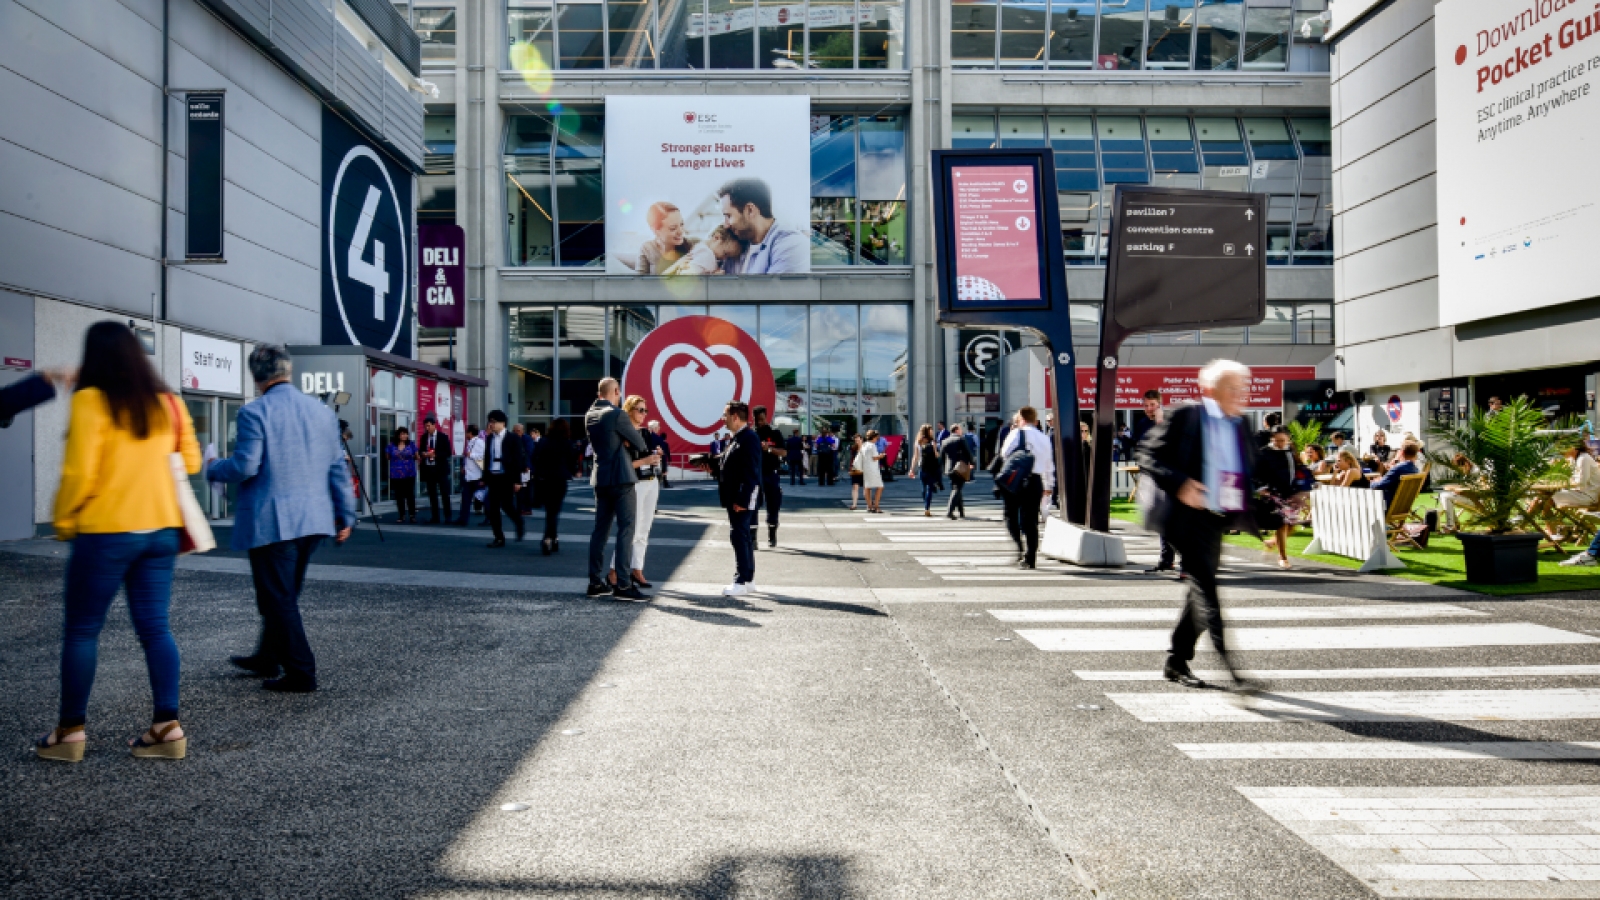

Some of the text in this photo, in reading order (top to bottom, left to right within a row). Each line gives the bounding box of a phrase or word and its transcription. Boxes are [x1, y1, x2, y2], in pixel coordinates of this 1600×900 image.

[1476, 32, 1553, 93] Pocket
[1477, 102, 1496, 124] ESC
[1498, 83, 1536, 114] clinical
[1537, 62, 1586, 99] practice
[1526, 82, 1591, 121] Anywhere
[697, 114, 718, 123] ESC
[661, 142, 756, 155] Stronger Hearts
[671, 158, 746, 170] Longer Lives
[1169, 208, 1176, 216] 7
[1126, 225, 1214, 235] convention centre
[348, 184, 389, 321] 4
[422, 247, 459, 266] DELI
[1126, 243, 1165, 253] parking
[434, 268, 447, 285] &
[193, 351, 233, 372] Staff only
[301, 371, 344, 394] DELI
